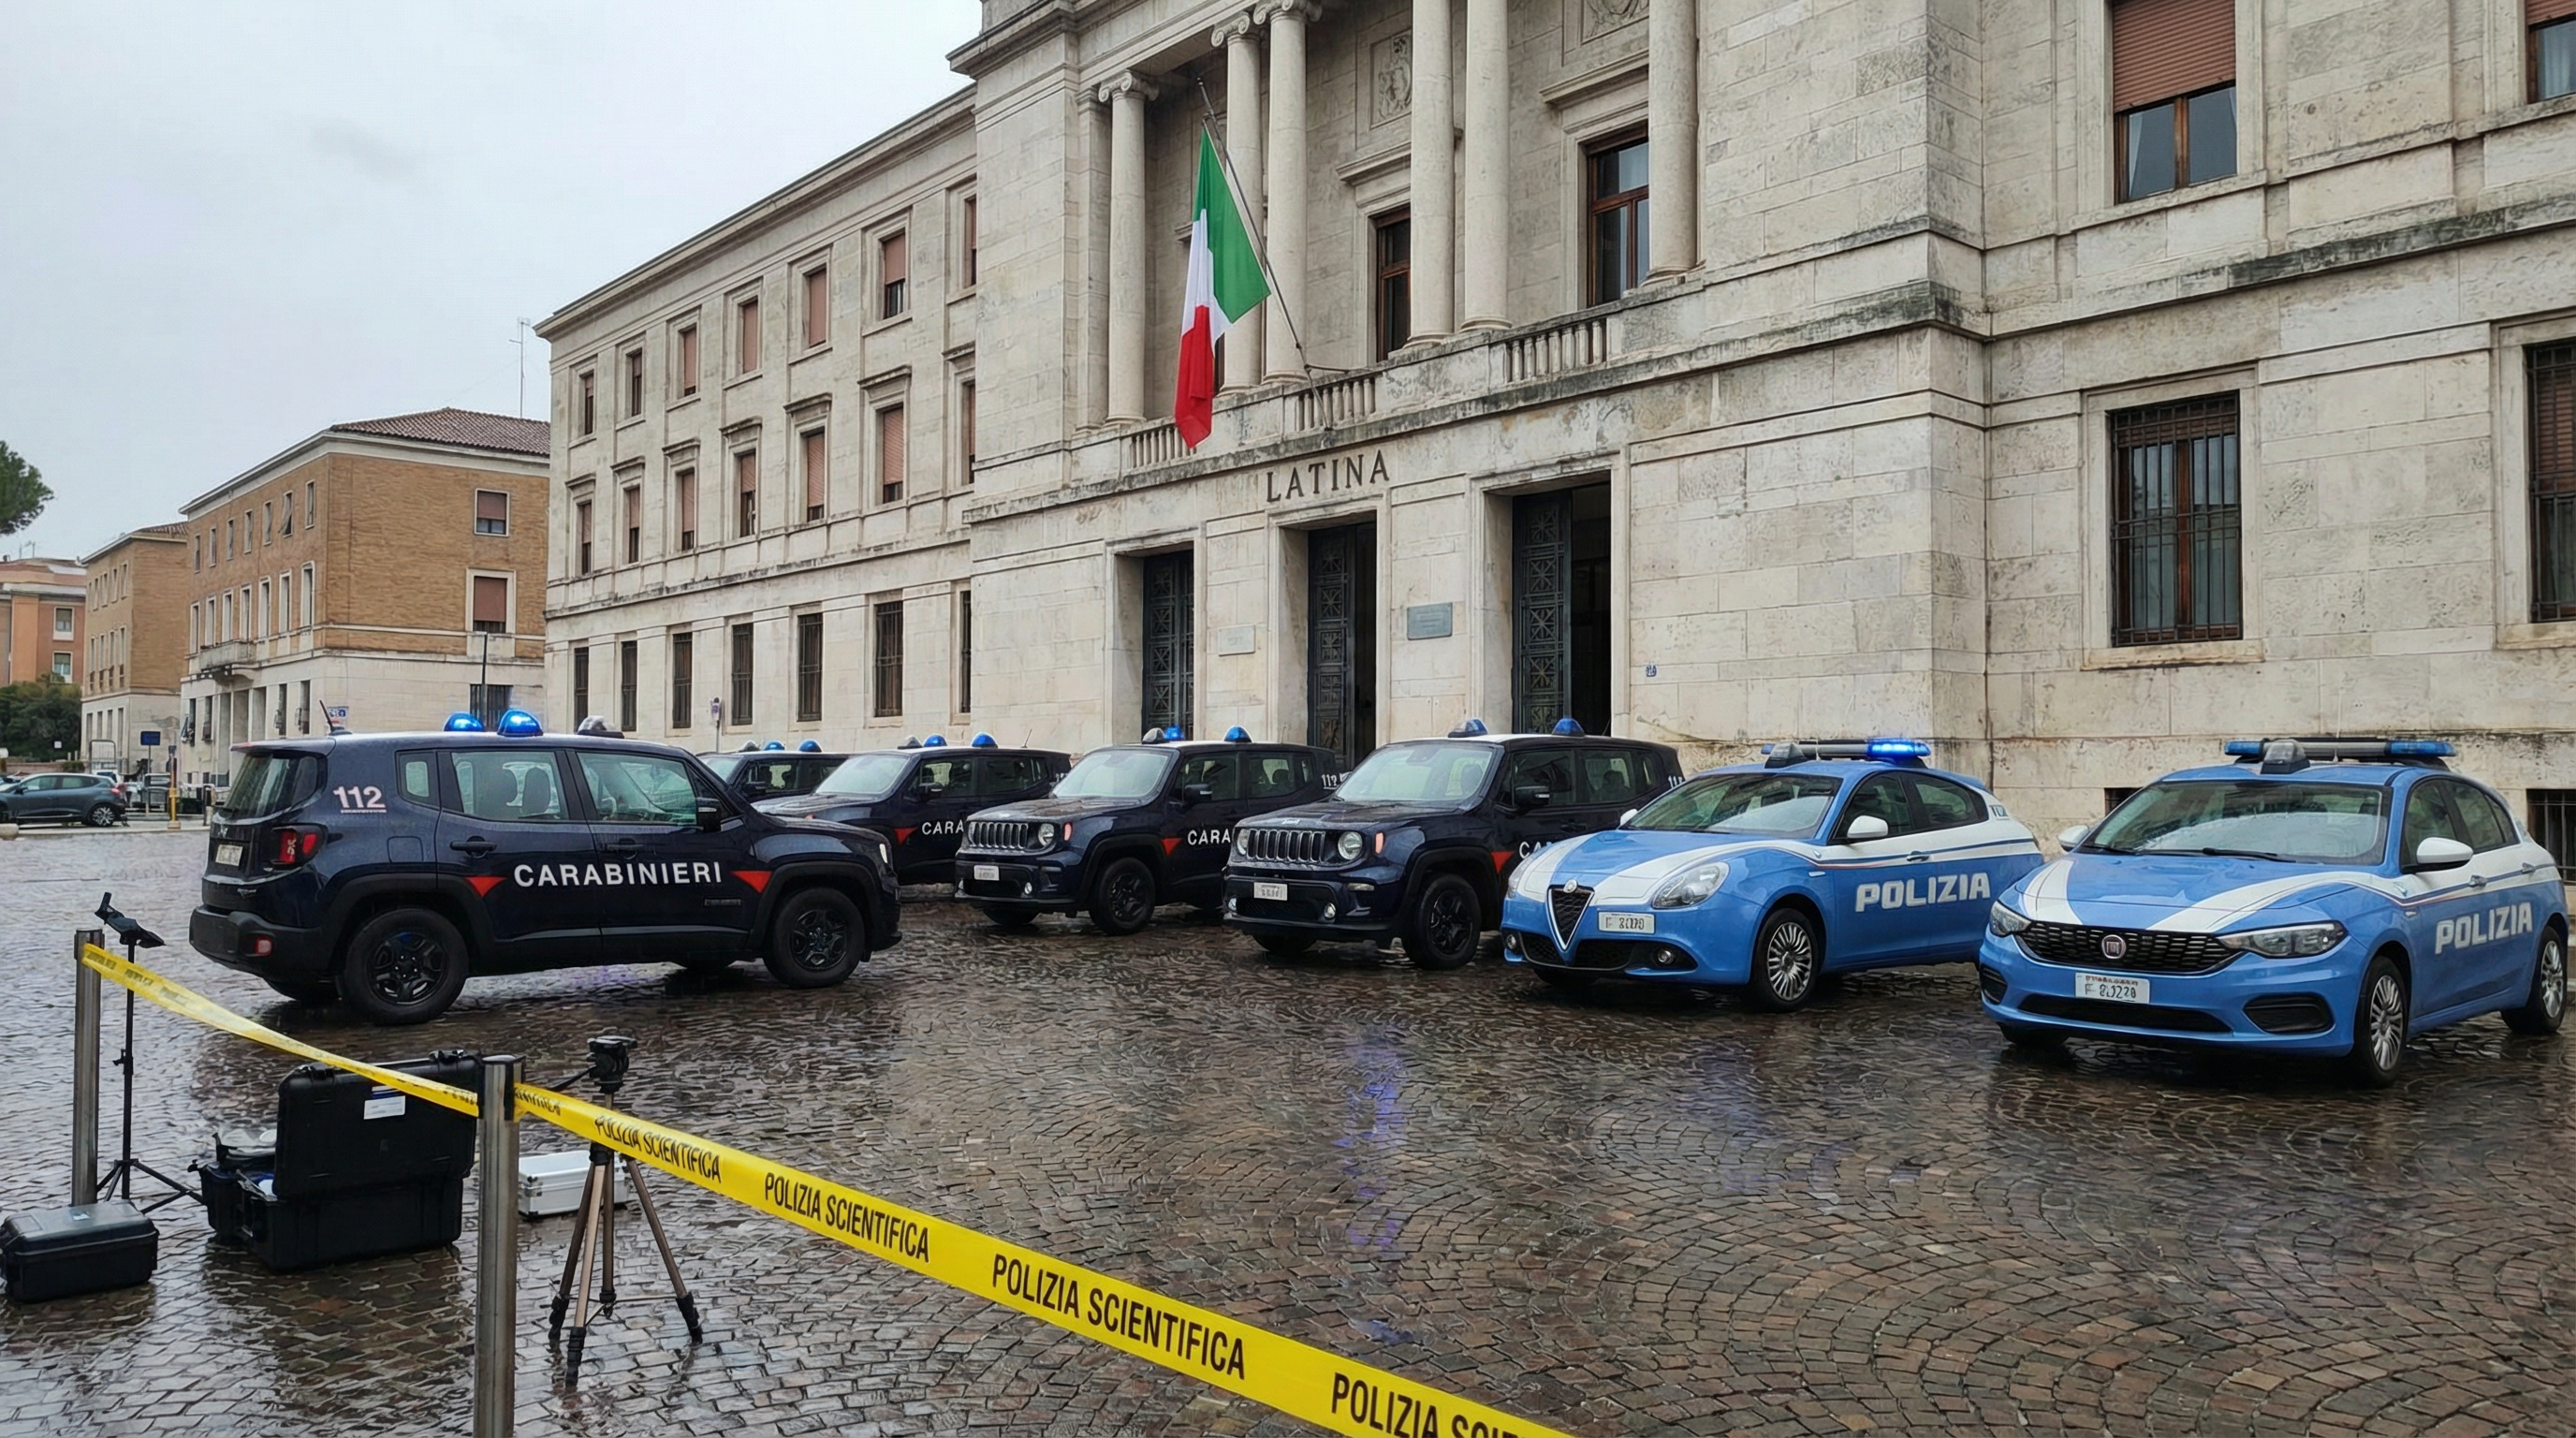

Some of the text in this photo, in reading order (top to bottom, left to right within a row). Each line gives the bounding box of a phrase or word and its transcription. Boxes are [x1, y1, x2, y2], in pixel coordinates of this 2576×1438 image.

[1266, 449, 1390, 503] LATINA
[332, 785, 387, 809] 112
[514, 861, 722, 888] CARABINIERI
[1855, 872, 1991, 913] POLIZIA
[2435, 902, 2533, 955] POLIZIA
[643, 1131, 722, 1183] SCIENTIFICA
[765, 1172, 929, 1263] POLIZIA SCIENTIFICA
[992, 1254, 1245, 1380] POLIZIA SCIENTIFICA
[1331, 1372, 1439, 1438] POLIZIA
